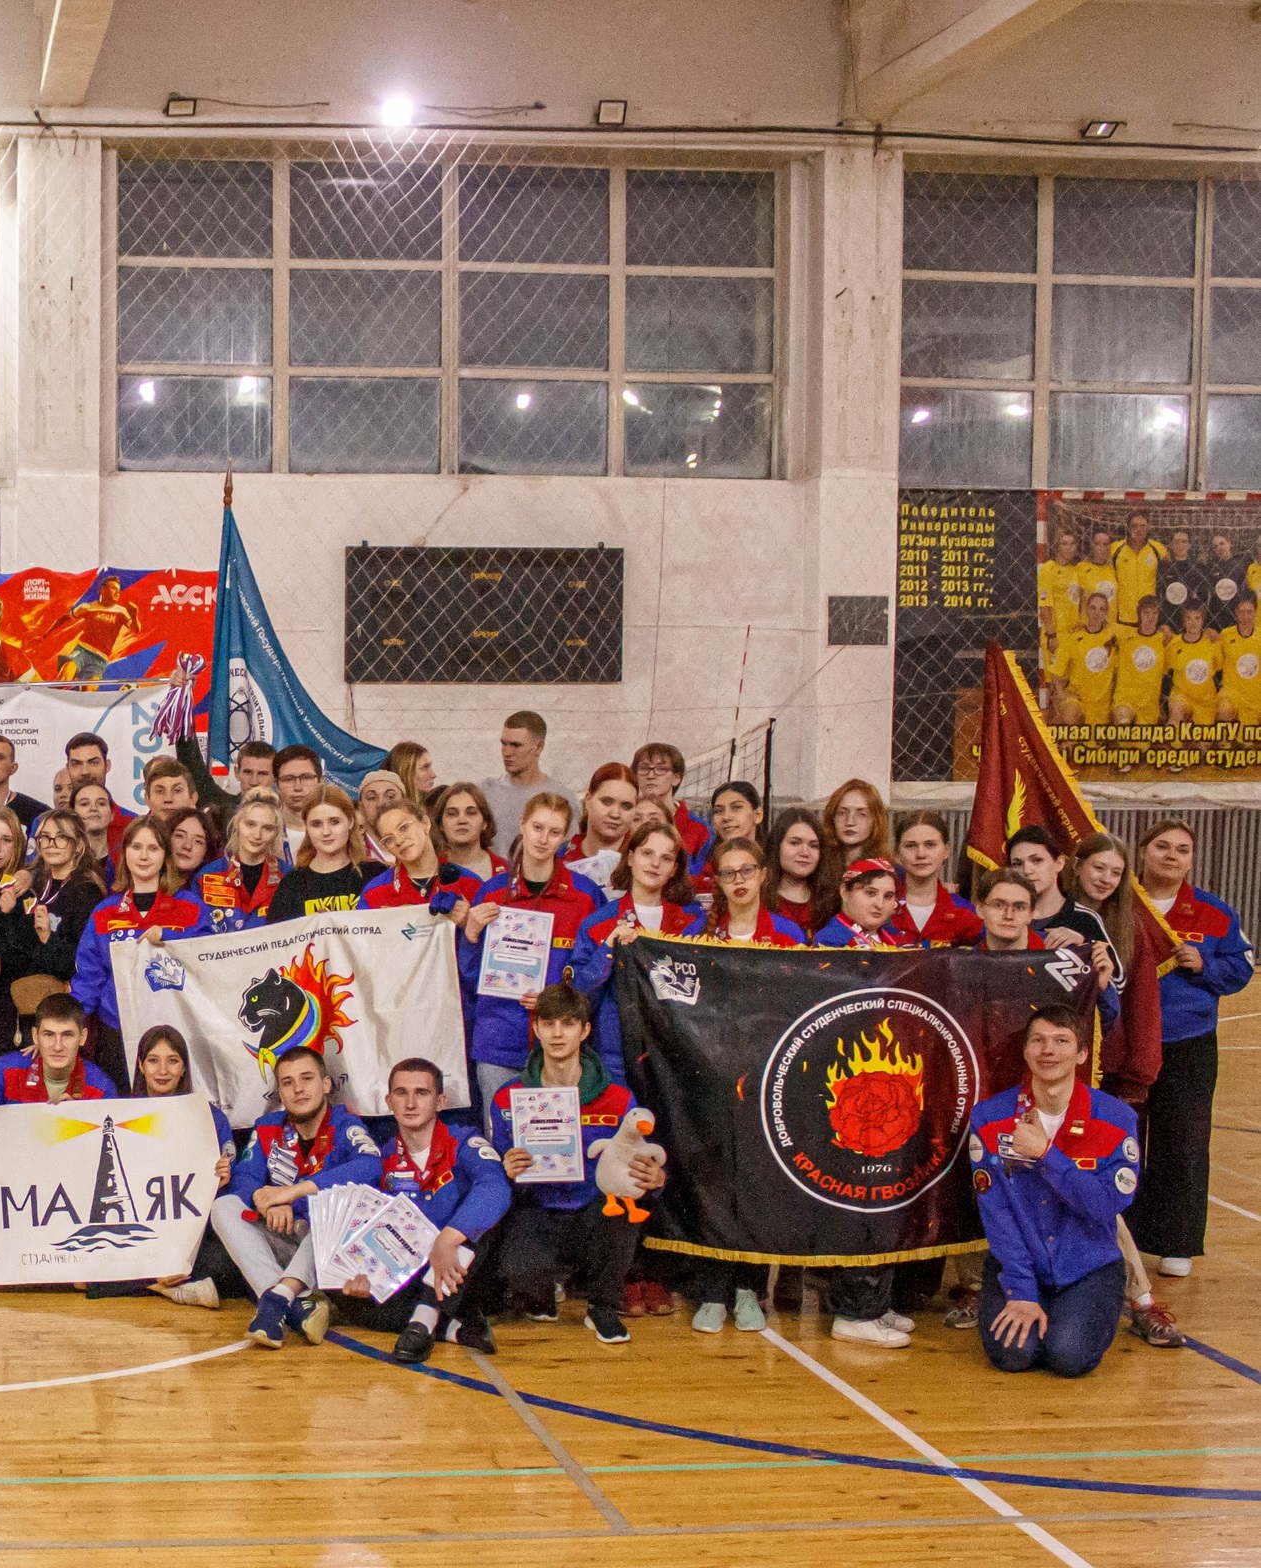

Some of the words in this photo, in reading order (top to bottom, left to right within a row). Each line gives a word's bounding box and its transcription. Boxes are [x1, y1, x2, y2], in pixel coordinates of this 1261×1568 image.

[901, 503, 996, 518] Победитель
[901, 518, 995, 534] Универсиады
[900, 534, 937, 547] ВУЗов
[940, 534, 995, 549] Кузбасса
[900, 549, 929, 562] 2010
[941, 550, 969, 562] 2011
[900, 564, 927, 577] 2011
[941, 565, 970, 577] 2012
[900, 579, 928, 592] 2012
[941, 580, 970, 593] 2013
[899, 594, 928, 607] 2013
[943, 595, 972, 607] 2014
[1048, 725, 1090, 743] рная
[1095, 724, 1175, 743] команда
[1180, 722, 1239, 741] КемГУ
[1074, 745, 1139, 768] Сибири
[1146, 750, 1200, 768] среди
[197, 941, 269, 962] СТУДЕНЧЕСКИЙ
[270, 926, 349, 950] ПЕДАГОГИЧЕСКИЙ
[351, 926, 382, 936] ОТРЯД
[674, 961, 697, 976] РСО
[772, 1036, 806, 1148] ДОБРОВОЛЬЧЕСКИЙ
[800, 997, 885, 1039] СТУДЕНЧЕСКИЙ
[886, 998, 970, 1095] СПЕЦИАЛИЗИРОВАННЫЙ
[792, 1151, 867, 1200] КРАСНАЯ
[860, 1164, 892, 1174] 1976
